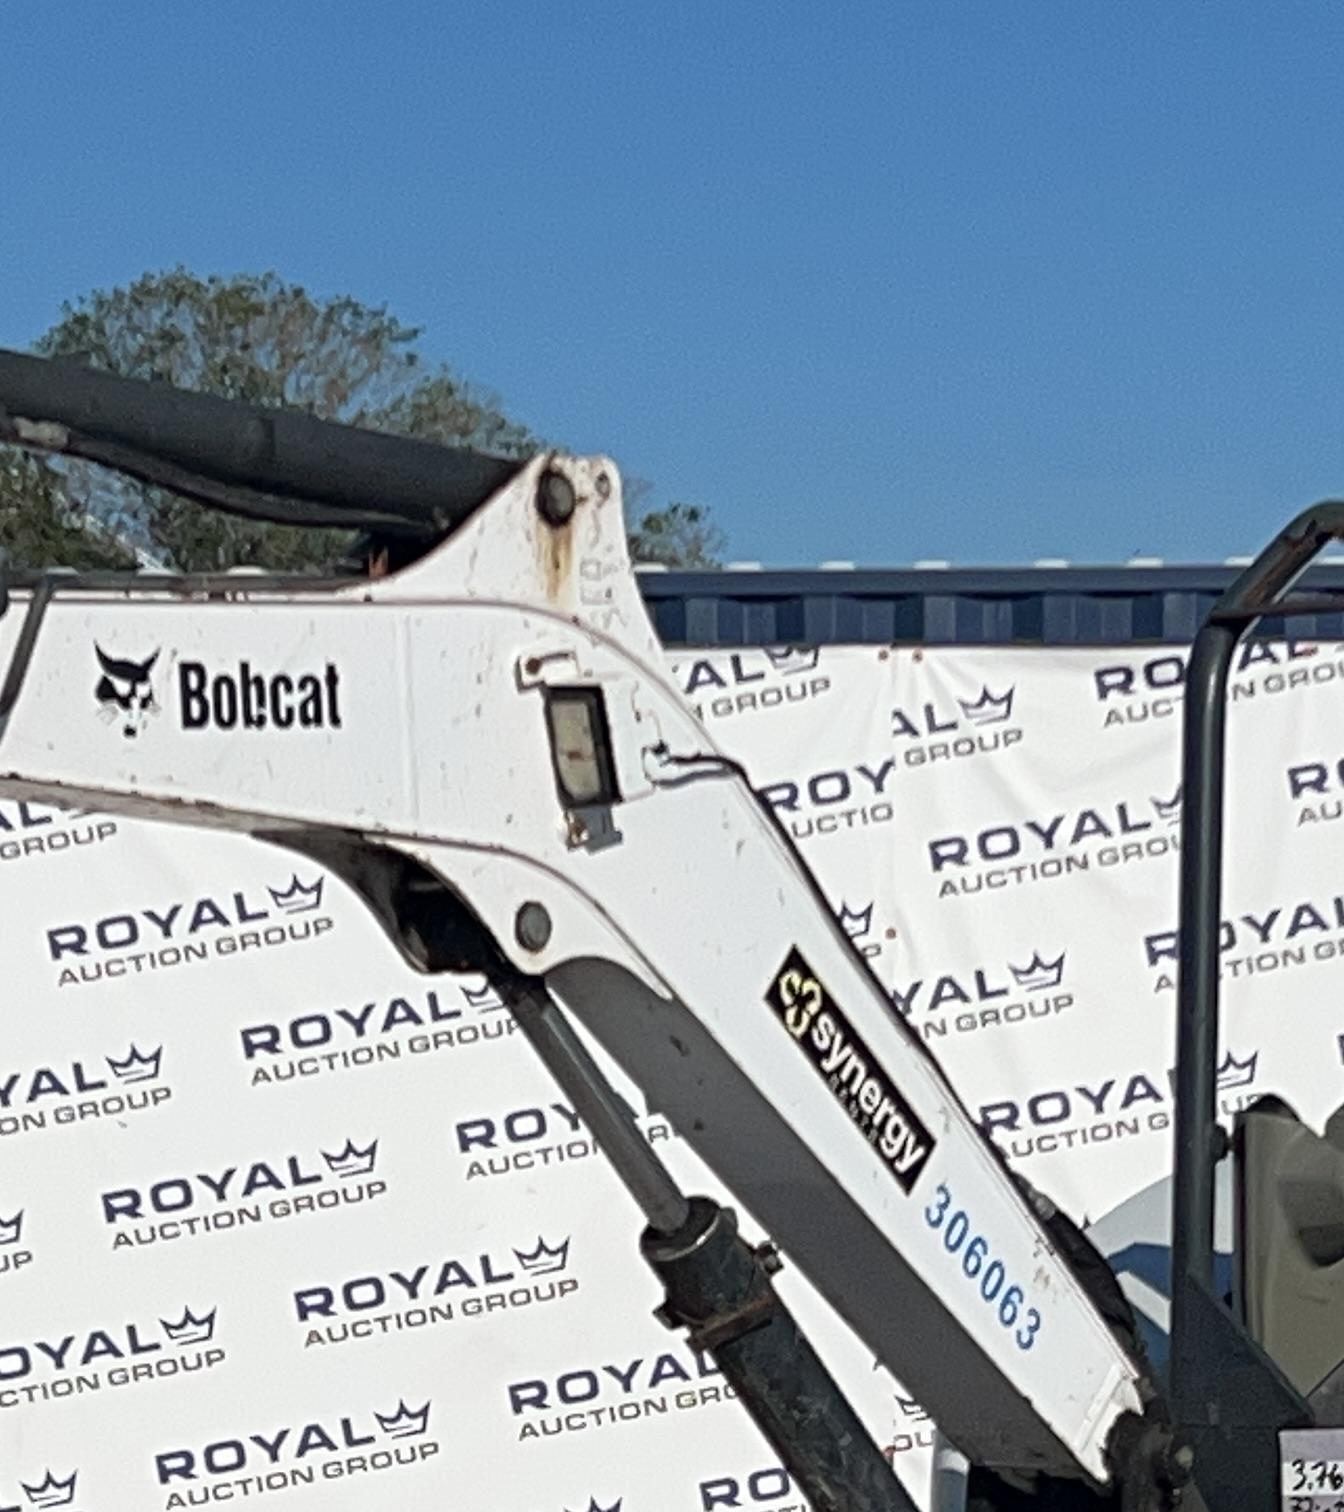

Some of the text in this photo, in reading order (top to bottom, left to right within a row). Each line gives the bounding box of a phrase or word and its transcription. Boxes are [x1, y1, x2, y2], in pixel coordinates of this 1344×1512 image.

[178, 660, 342, 730] Bobcat
[711, 677, 831, 718] GROUP
[903, 728, 1023, 767] GROUP
[927, 801, 1153, 873] ROYAL
[938, 852, 1090, 899] AUCTION
[46, 891, 270, 962] ROYAL
[58, 916, 334, 988] AUCTION GROUP
[239, 991, 463, 1061] ROYAL
[954, 993, 1074, 1033] GROUP
[251, 1040, 401, 1087] AUCTION
[811, 1013, 926, 1174] synergy
[52, 1086, 172, 1125] GROUP
[1011, 1117, 1140, 1158] UCTION
[100, 1154, 324, 1225] ROYAL
[112, 1180, 387, 1251] AUCTION GROUP
[293, 1253, 515, 1323] ROYAL
[922, 1184, 1043, 1352] 306063
[304, 1278, 579, 1348] AUCTION GROUP
[107, 1348, 226, 1387] GROUP
[154, 1417, 377, 1486] ROYAL
[518, 1396, 669, 1442] AUCTION
[165, 1441, 440, 1511] AUCTION GROUP
